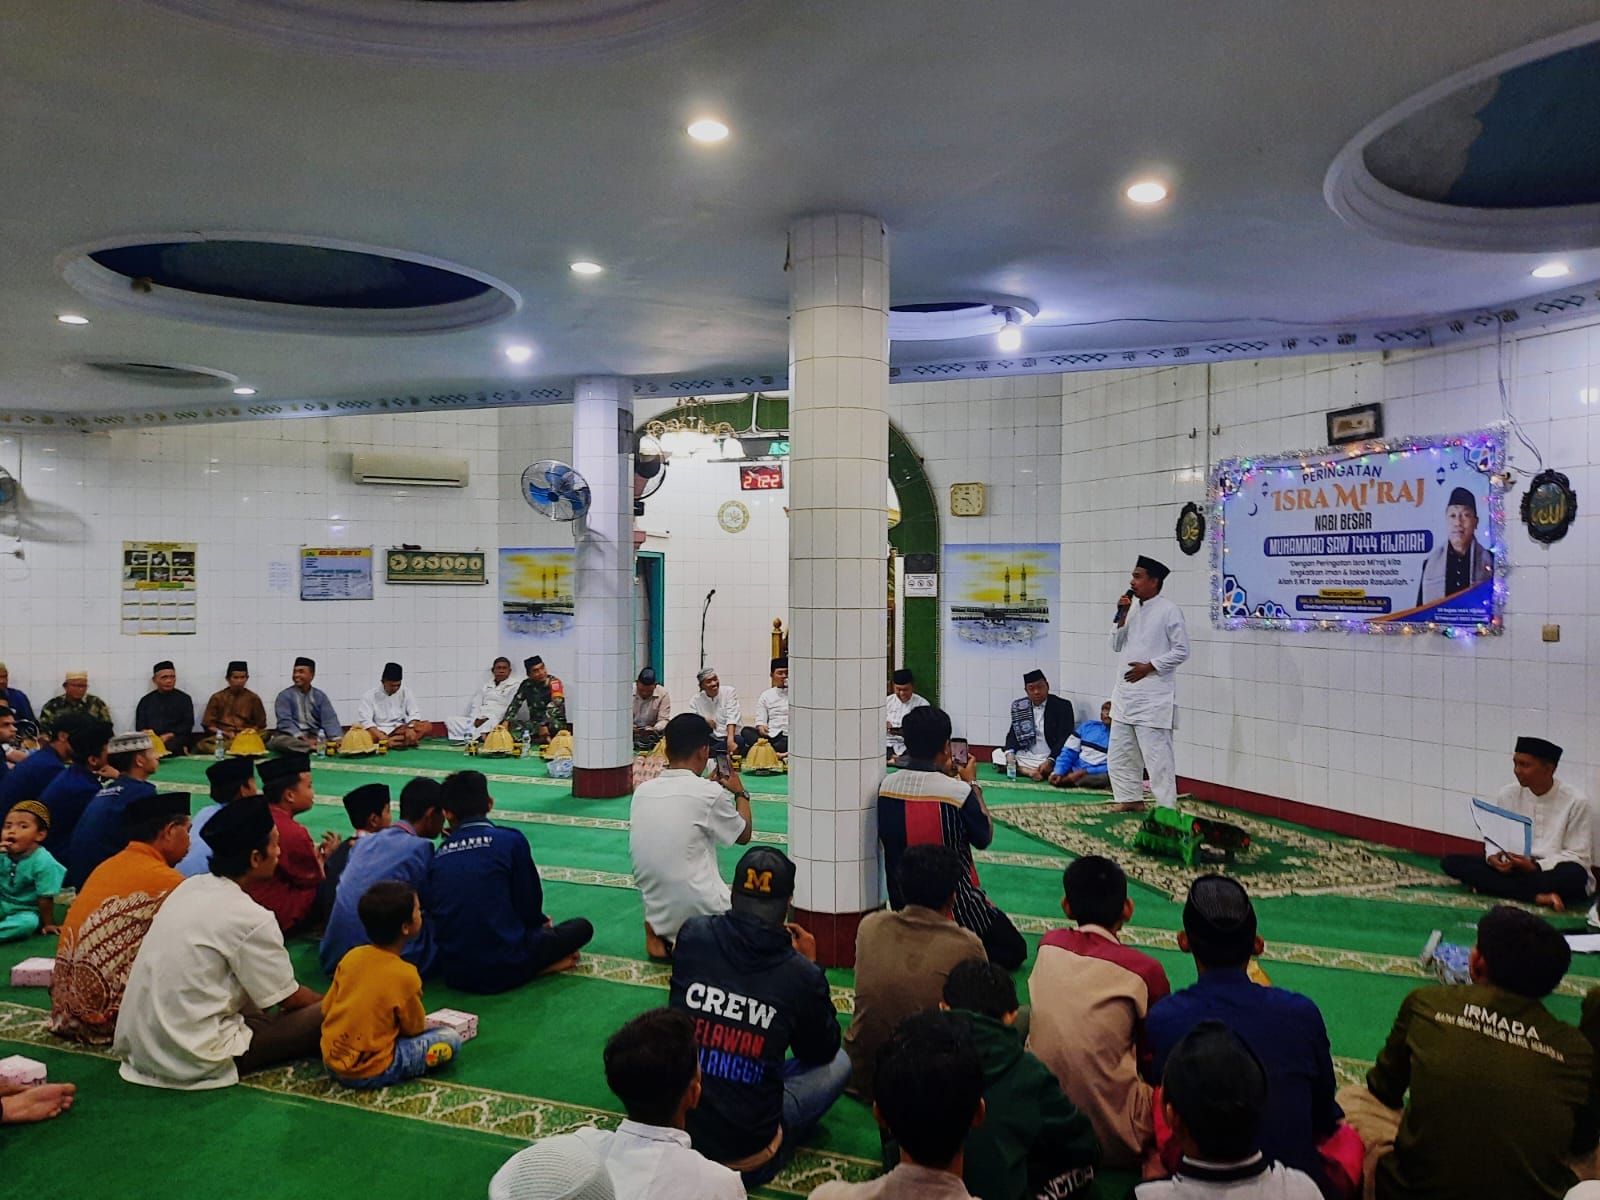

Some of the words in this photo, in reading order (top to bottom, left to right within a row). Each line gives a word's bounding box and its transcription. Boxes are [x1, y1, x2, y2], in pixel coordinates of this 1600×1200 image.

[1302, 465, 1382, 485] PERINGATAN
[1271, 487, 1329, 512] ISRA
[1333, 478, 1424, 512] MI'RAJ
[1315, 514, 1338, 531] NABI
[1340, 512, 1372, 530] BESAR
[1269, 536, 1325, 555] MUHAMMAD
[1326, 535, 1351, 554] SAW
[1352, 534, 1378, 553] 1444
[1380, 533, 1425, 552] HIJRIAH
[744, 868, 773, 892] M
[686, 983, 778, 1029] CREW
[693, 1018, 766, 1058] ELAWAN
